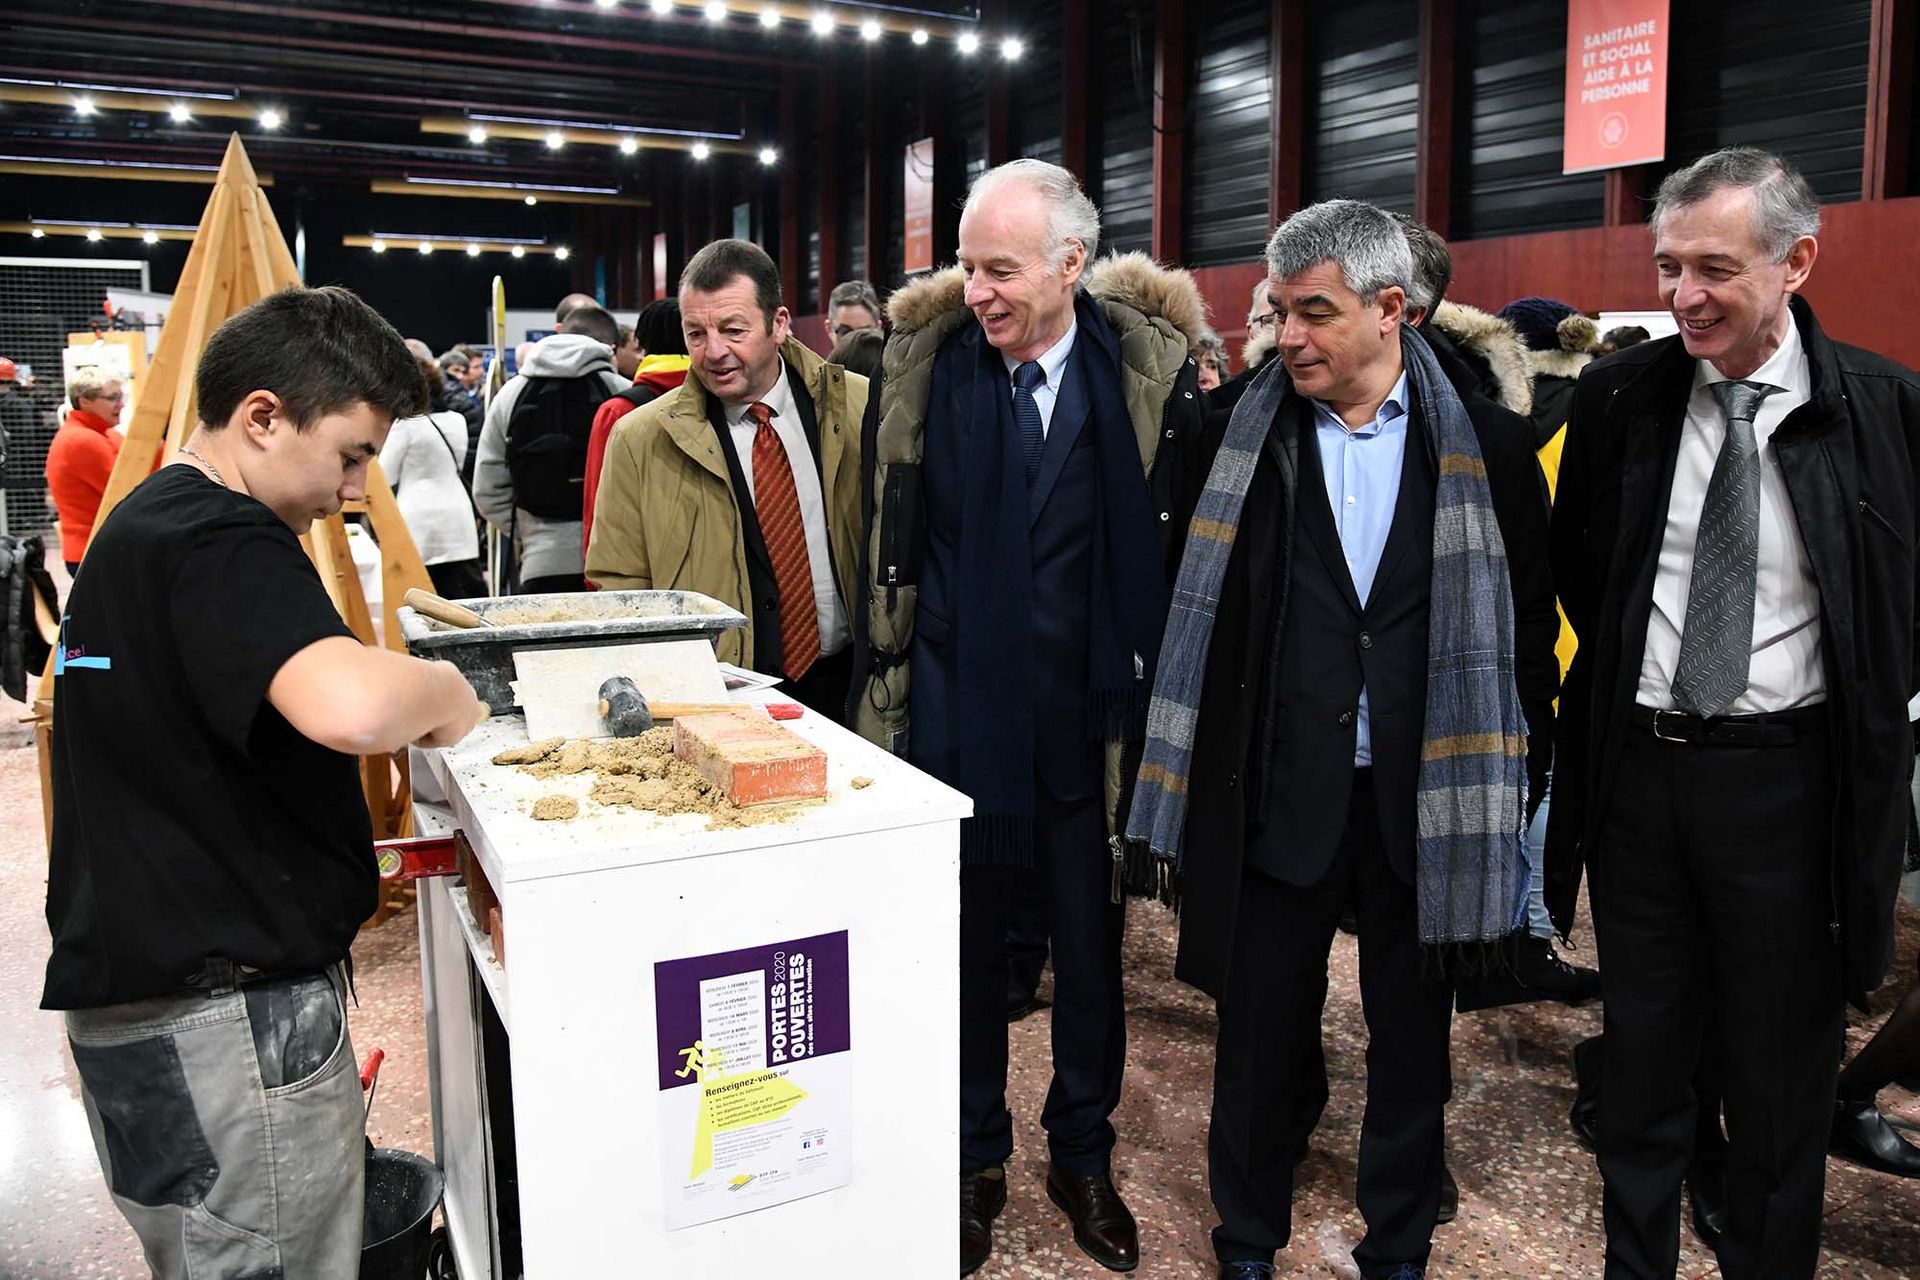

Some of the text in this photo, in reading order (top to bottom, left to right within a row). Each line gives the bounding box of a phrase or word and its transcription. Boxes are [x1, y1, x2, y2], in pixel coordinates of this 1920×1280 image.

[1584, 20, 1656, 49] SANITAIRE
[1582, 42, 1651, 68] ET SOCIAL
[1584, 60, 1653, 84] AIDE À LA
[1581, 79, 1649, 104] PERSONNE
[771, 951, 787, 1062] PORTES 2020
[789, 953, 806, 1057] OUVERTES
[705, 1072, 778, 1097] Renseignez-vous
